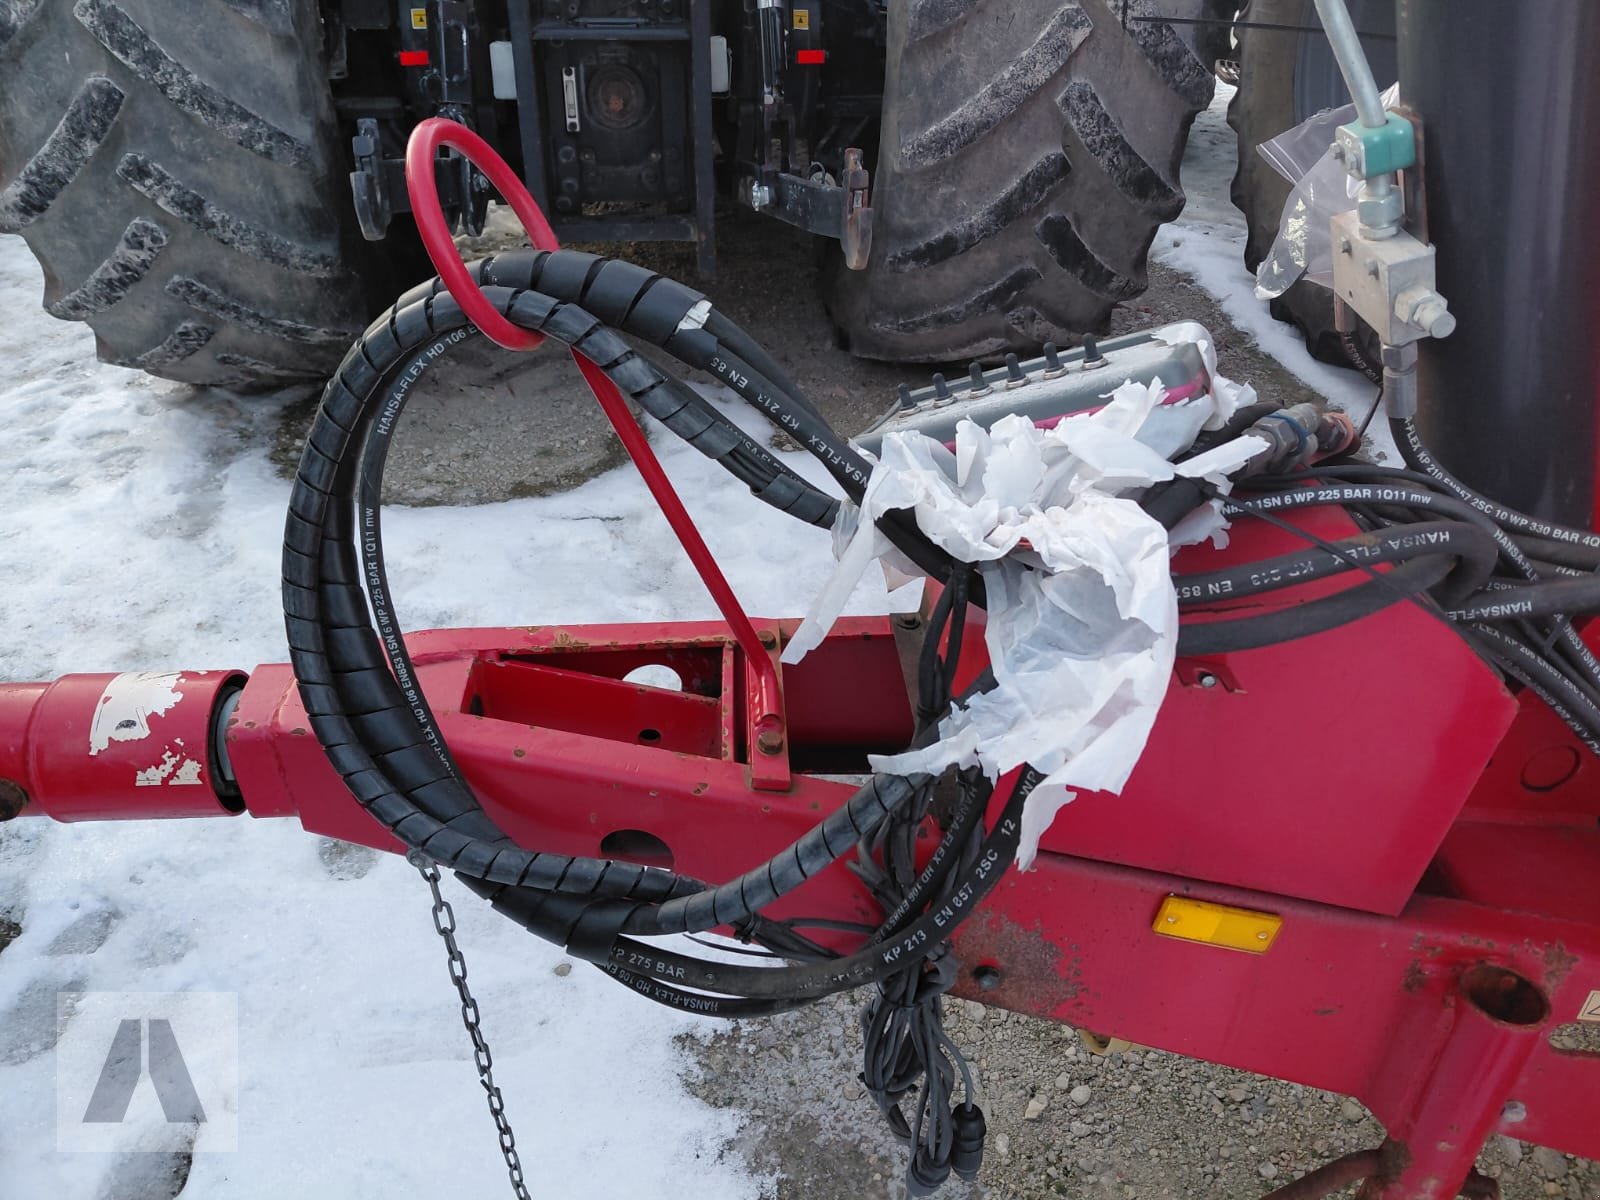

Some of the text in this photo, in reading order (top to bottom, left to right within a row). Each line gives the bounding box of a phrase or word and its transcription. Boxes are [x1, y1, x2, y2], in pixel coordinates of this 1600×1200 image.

[710, 357, 728, 373] 85
[377, 358, 428, 435] HANSA-FLEX
[426, 343, 445, 359] HD
[446, 329, 467, 345] 106
[728, 369, 749, 389] EN
[780, 414, 800, 430] KP
[807, 434, 869, 489] NSA-FLEX
[1256, 496, 1281, 509] 1SN
[1284, 494, 1292, 504] 6
[1293, 491, 1315, 504] WP
[1318, 488, 1341, 501] 225
[1344, 487, 1372, 499] BAR
[1376, 488, 1407, 501] 1Q11
[1410, 493, 1432, 504] mw
[1416, 451, 1431, 464] KP
[1470, 497, 1494, 514] 2SC
[1495, 509, 1508, 521] 10
[1509, 514, 1529, 527] WP
[1529, 522, 1551, 536] 330
[1552, 529, 1580, 544] BAR
[365, 507, 374, 527] mw
[365, 531, 376, 558] 1Q11
[368, 561, 380, 586] BAR
[372, 588, 385, 607] 225
[1208, 580, 1233, 595] EN
[377, 608, 390, 626] WP
[1448, 601, 1532, 621] HANSA-FLE
[385, 635, 400, 656] 1SN
[393, 657, 412, 689] EN853
[405, 689, 418, 707] 106
[414, 708, 427, 723] HD
[932, 785, 978, 865] HANSA-FLEX
[921, 864, 935, 884] HD
[882, 946, 901, 964] KP
[904, 929, 927, 951] 213
[934, 905, 954, 927] EN
[952, 882, 974, 908] 857
[976, 849, 998, 880] 2SC
[1001, 819, 1016, 836] 12
[908, 882, 922, 902] 106
[629, 953, 652, 969] 275
[656, 962, 685, 979] BAR
[618, 970, 634, 984] 106
[636, 980, 651, 993] HD
[655, 987, 719, 1012] HANSA-FLEX
